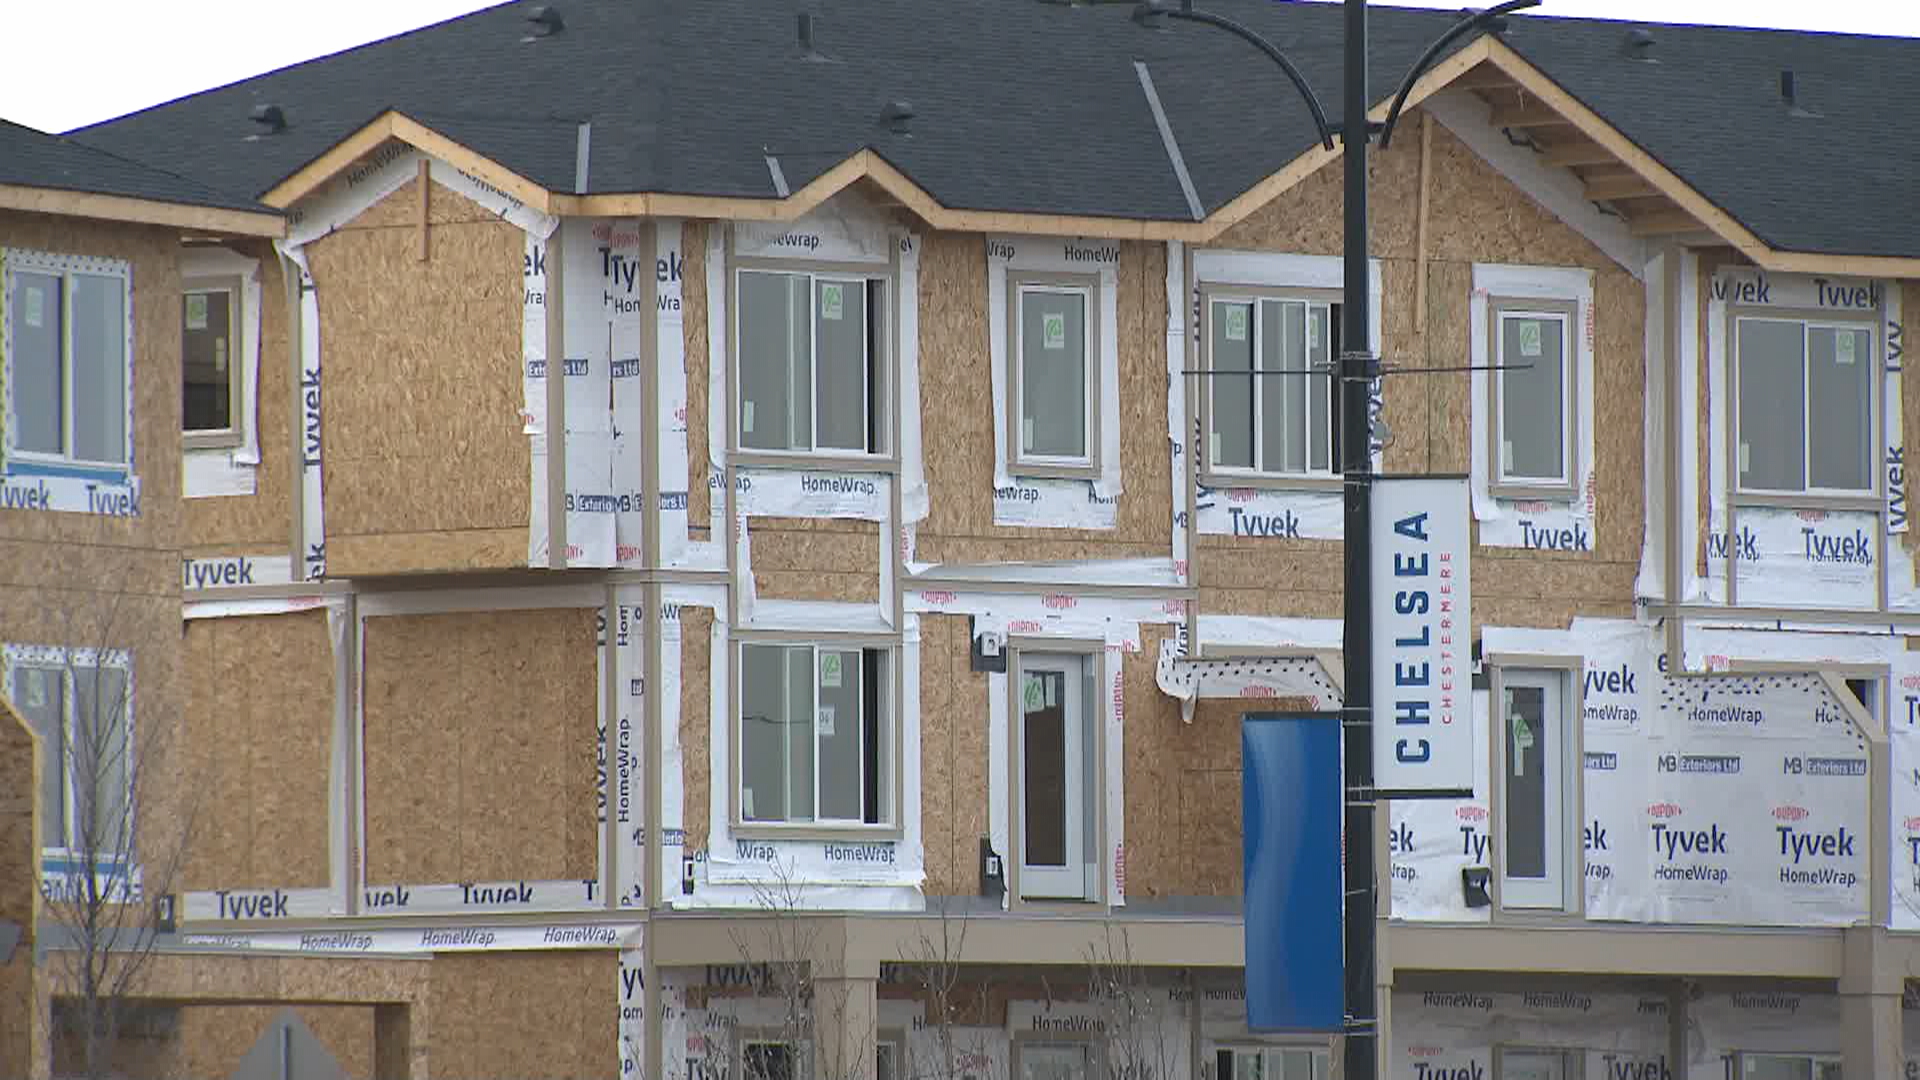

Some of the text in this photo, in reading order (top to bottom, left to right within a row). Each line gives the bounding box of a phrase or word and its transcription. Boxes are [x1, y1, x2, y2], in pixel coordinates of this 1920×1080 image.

[773, 231, 820, 255] eWrap
[987, 240, 1120, 263] Wrap HomeWr
[801, 475, 875, 495] HomeWrap
[993, 486, 1040, 504] eWrap
[1228, 508, 1299, 539] Tyvek
[1518, 520, 1587, 550] Tyvek
[1801, 528, 1869, 558] Tyvek
[183, 557, 252, 588] Tyvek
[1394, 511, 1430, 764] CHELSEA
[1441, 552, 1452, 724] CHESTERMERE
[1583, 663, 1635, 700] yvek
[1584, 705, 1638, 724] omeWrap
[1688, 706, 1762, 726] HomeWrap
[618, 719, 631, 822] HomeWrap
[1658, 755, 1677, 772] MB
[1783, 757, 1802, 775] MB
[1774, 806, 1808, 820] DUPONT
[1651, 823, 1727, 860] Tyvek
[1776, 826, 1854, 863] Tyvek
[738, 845, 774, 862] Wrap
[824, 845, 896, 865] HomeWrap
[1655, 865, 1728, 883] HomeWrap
[1780, 868, 1856, 887] HomeWrap
[215, 889, 288, 920] Tyvek
[300, 933, 373, 950] HomeWrap
[421, 929, 494, 946] HomeWrap
[544, 926, 616, 944] HomeWrap
[1423, 991, 1493, 1012] HomeWrap
[1522, 991, 1592, 1012] HomeWrap
